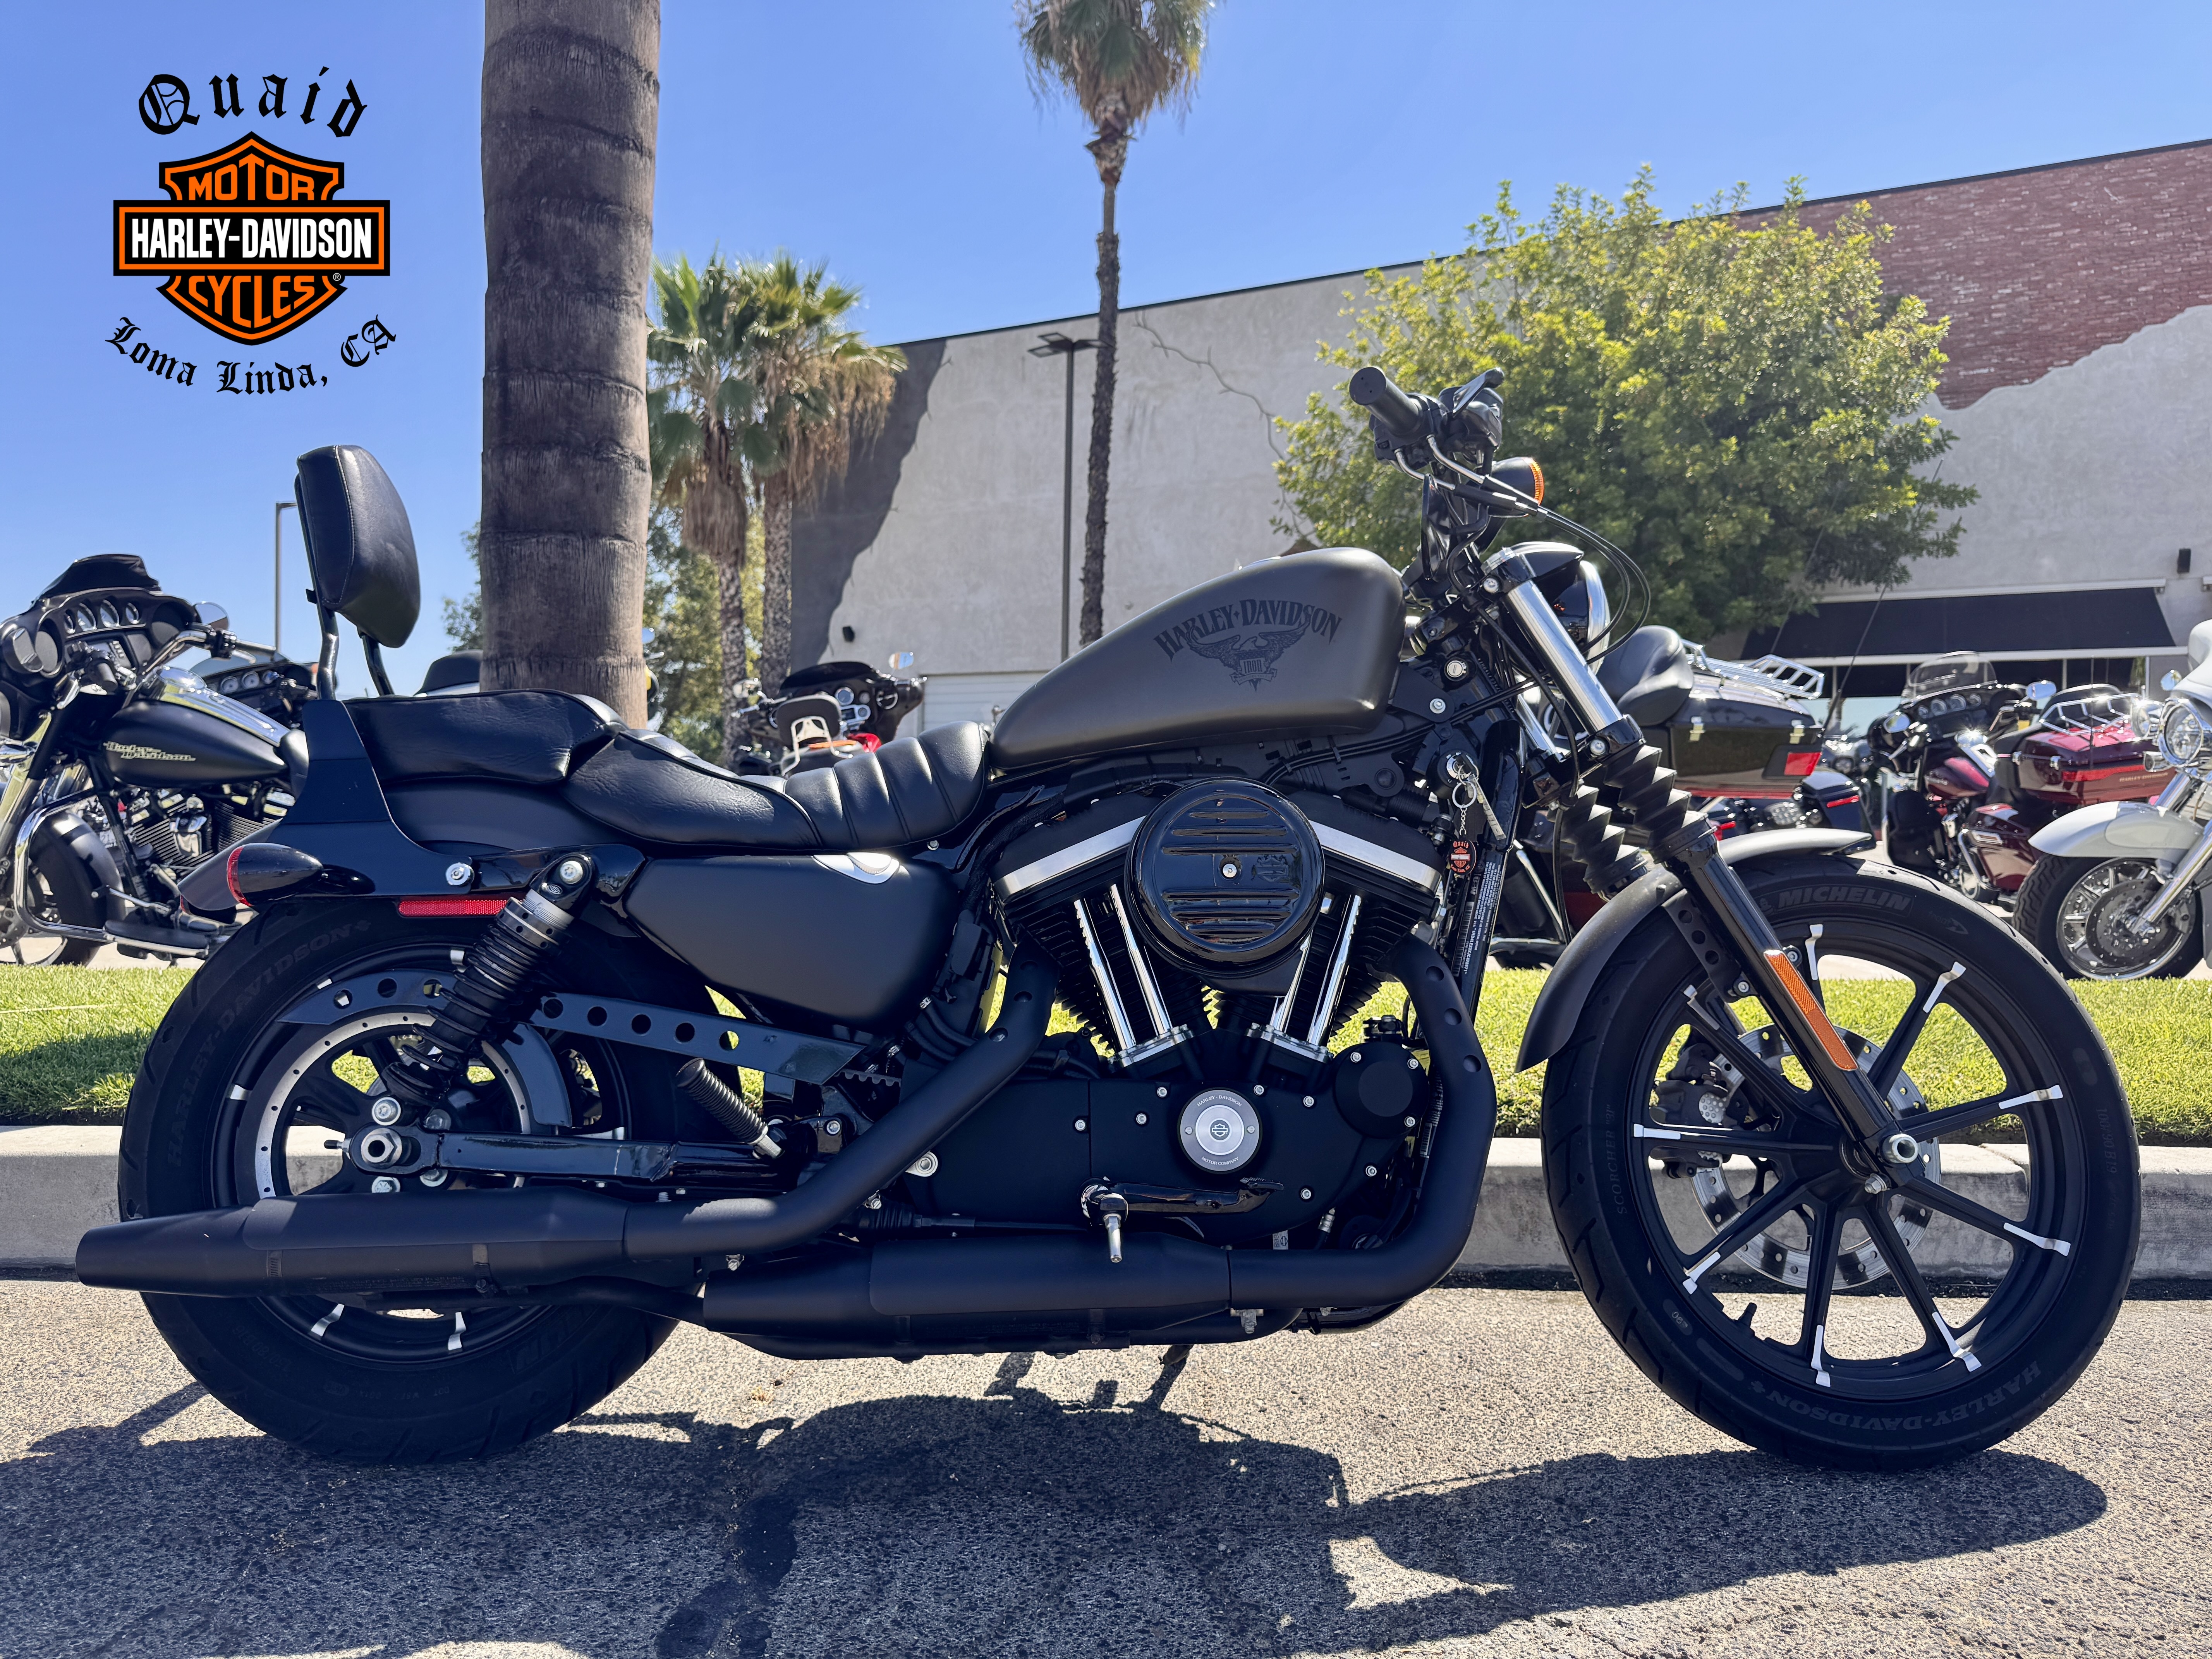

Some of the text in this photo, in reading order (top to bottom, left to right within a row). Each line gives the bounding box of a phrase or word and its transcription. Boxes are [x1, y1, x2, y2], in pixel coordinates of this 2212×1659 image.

[1778, 886, 1912, 911] MICHELIN
[1201, 1156, 1239, 1166] MOTOR COMPANY
[1606, 1130, 1627, 1215] SCORCHER
[1766, 1361, 2042, 1431] HARLEY-DAVIDSON
